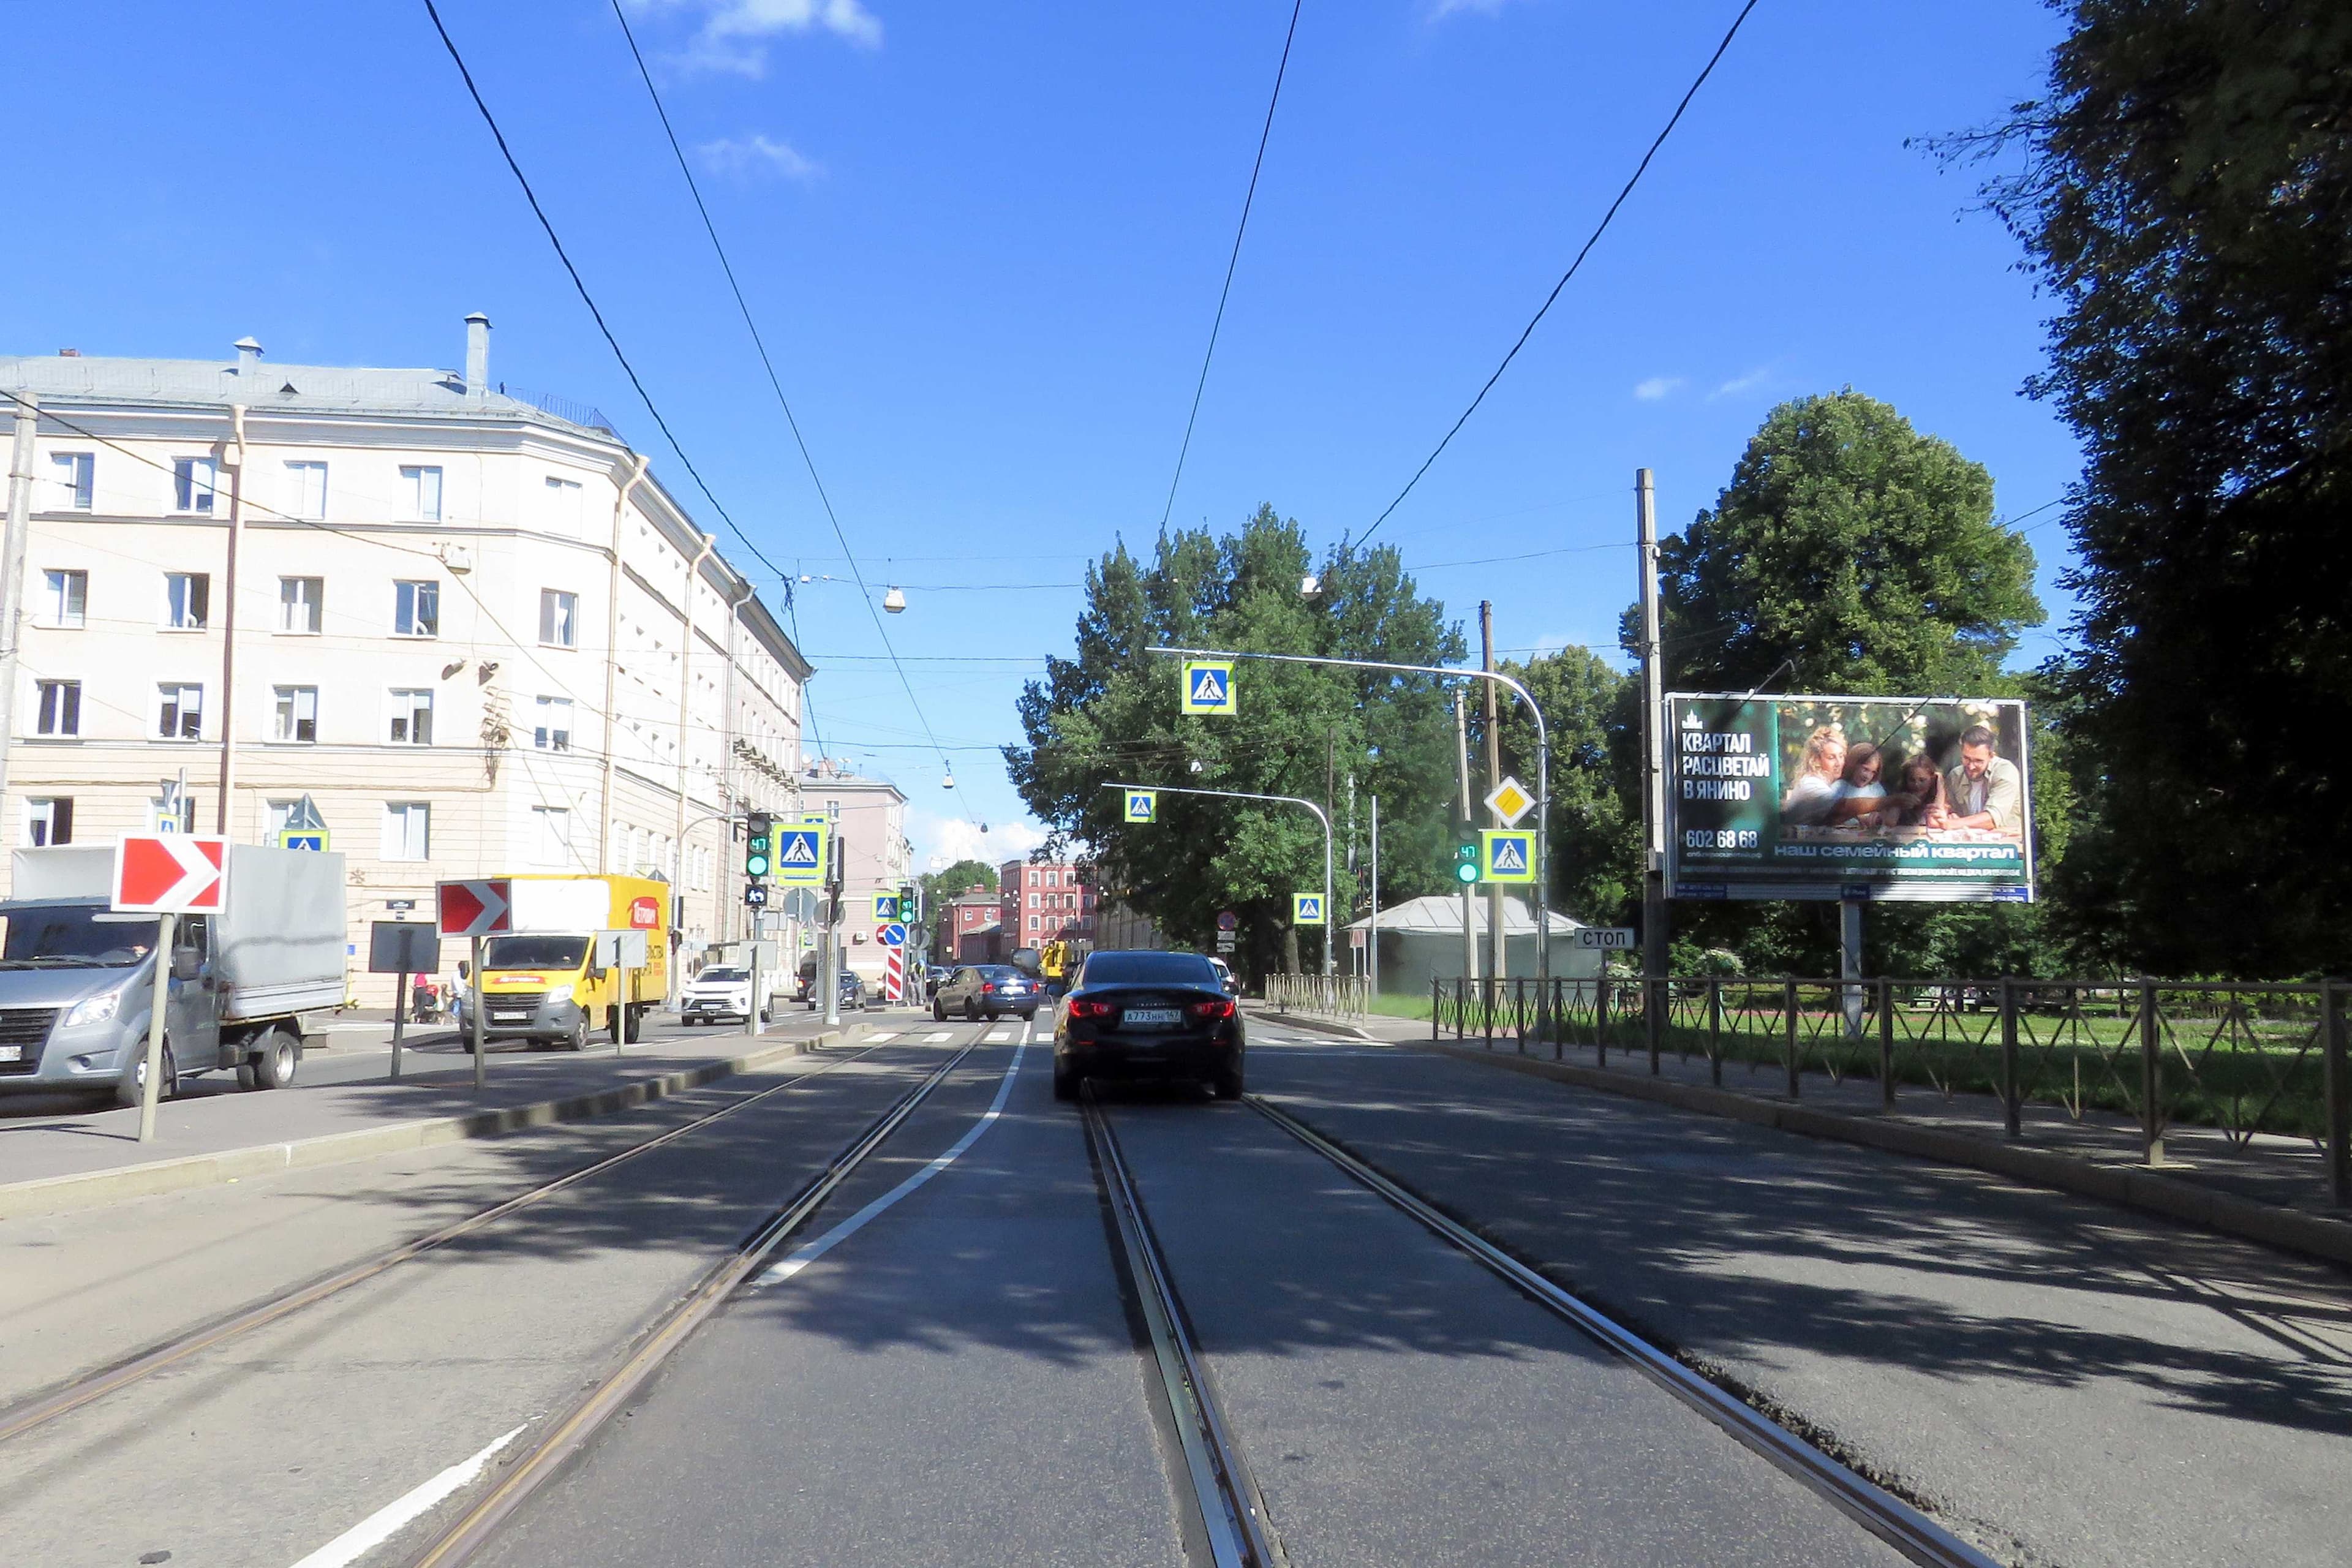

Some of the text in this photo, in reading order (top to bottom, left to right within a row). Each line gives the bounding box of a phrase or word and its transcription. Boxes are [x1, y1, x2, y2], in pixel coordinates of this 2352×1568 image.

[1682, 733, 1751, 753] КВАРТАЛ
[1683, 753, 1770, 778] РАСЦВЕТАЙ
[1683, 780, 1751, 801] В ЯНИНО
[752, 838, 766, 850] 47
[1686, 830, 1758, 848] 602 68 68
[1461, 846, 1476, 858] 47
[1774, 845, 1817, 857] наш
[1820, 842, 1929, 858] семейный
[1931, 847, 2015, 862] квартал
[1583, 932, 1625, 945] СТОП
